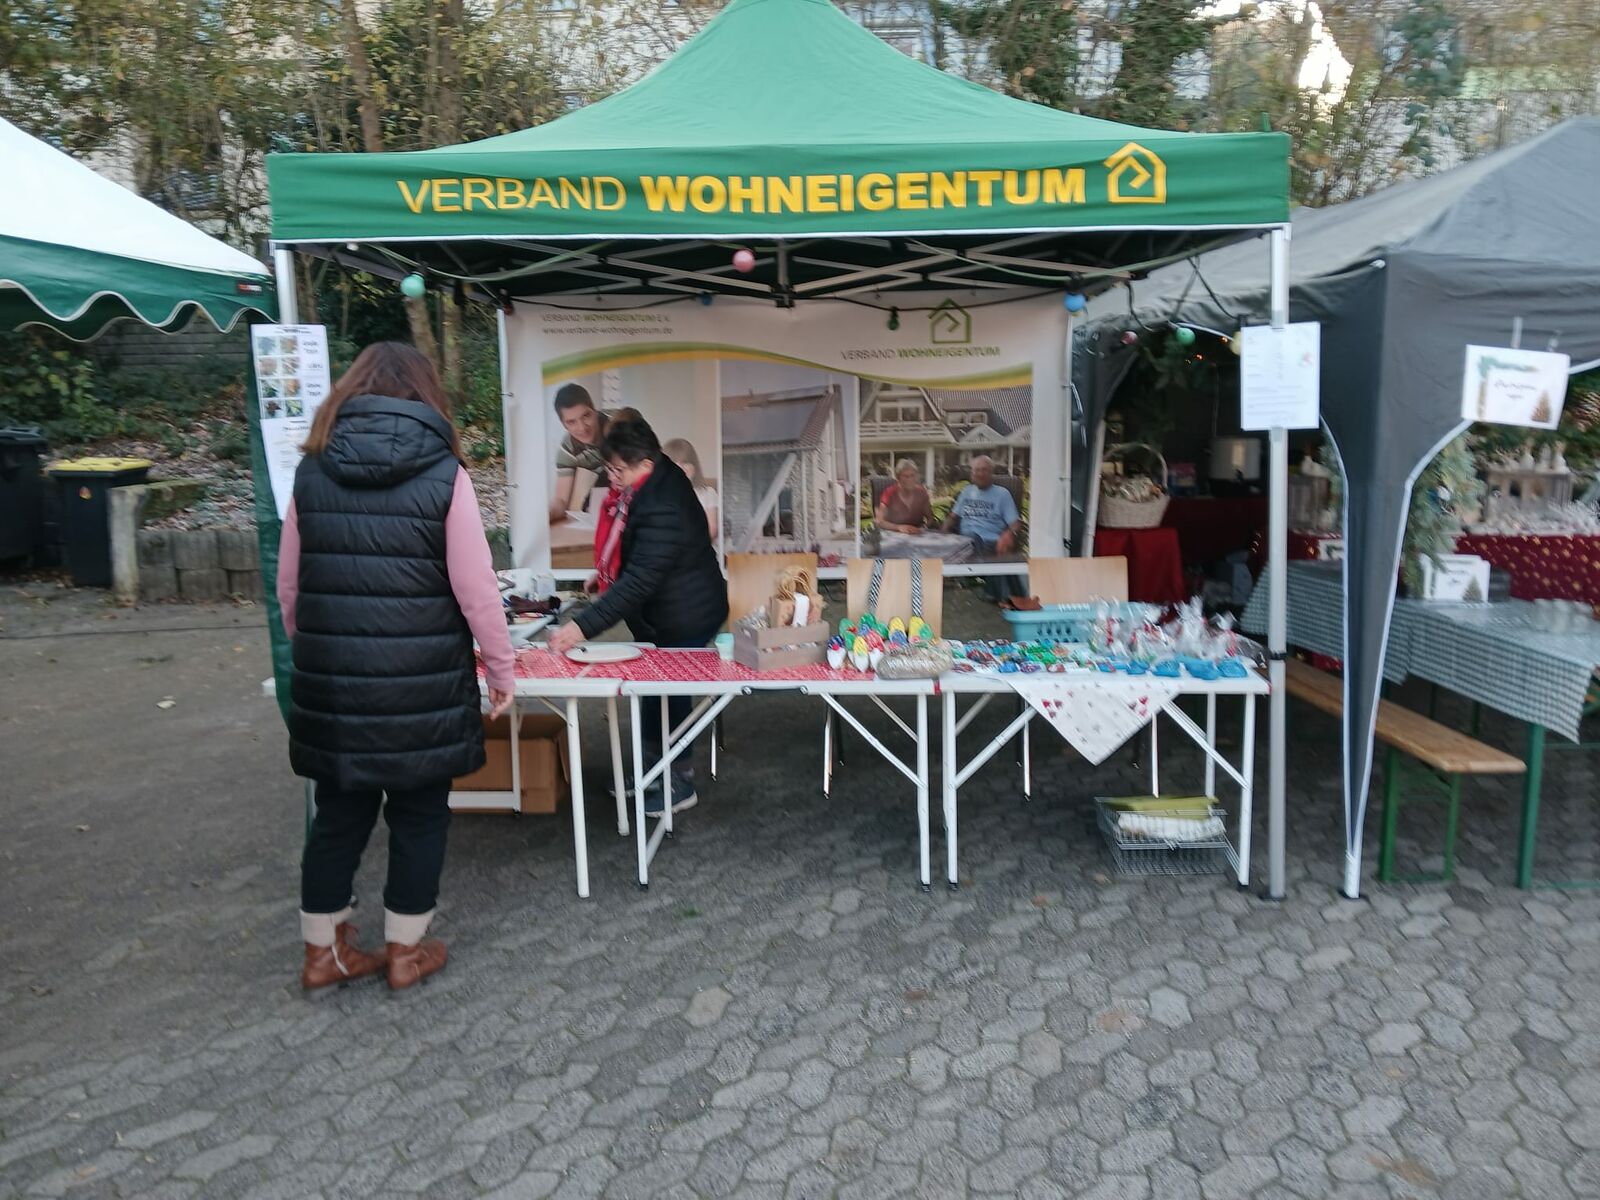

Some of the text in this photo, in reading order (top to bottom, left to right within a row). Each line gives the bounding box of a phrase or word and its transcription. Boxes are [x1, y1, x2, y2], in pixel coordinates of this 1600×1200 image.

[396, 168, 1087, 213] VERBAND WOHNEIGENTUM
[840, 346, 1000, 360] VERBAND WOHNEIGENTUM
